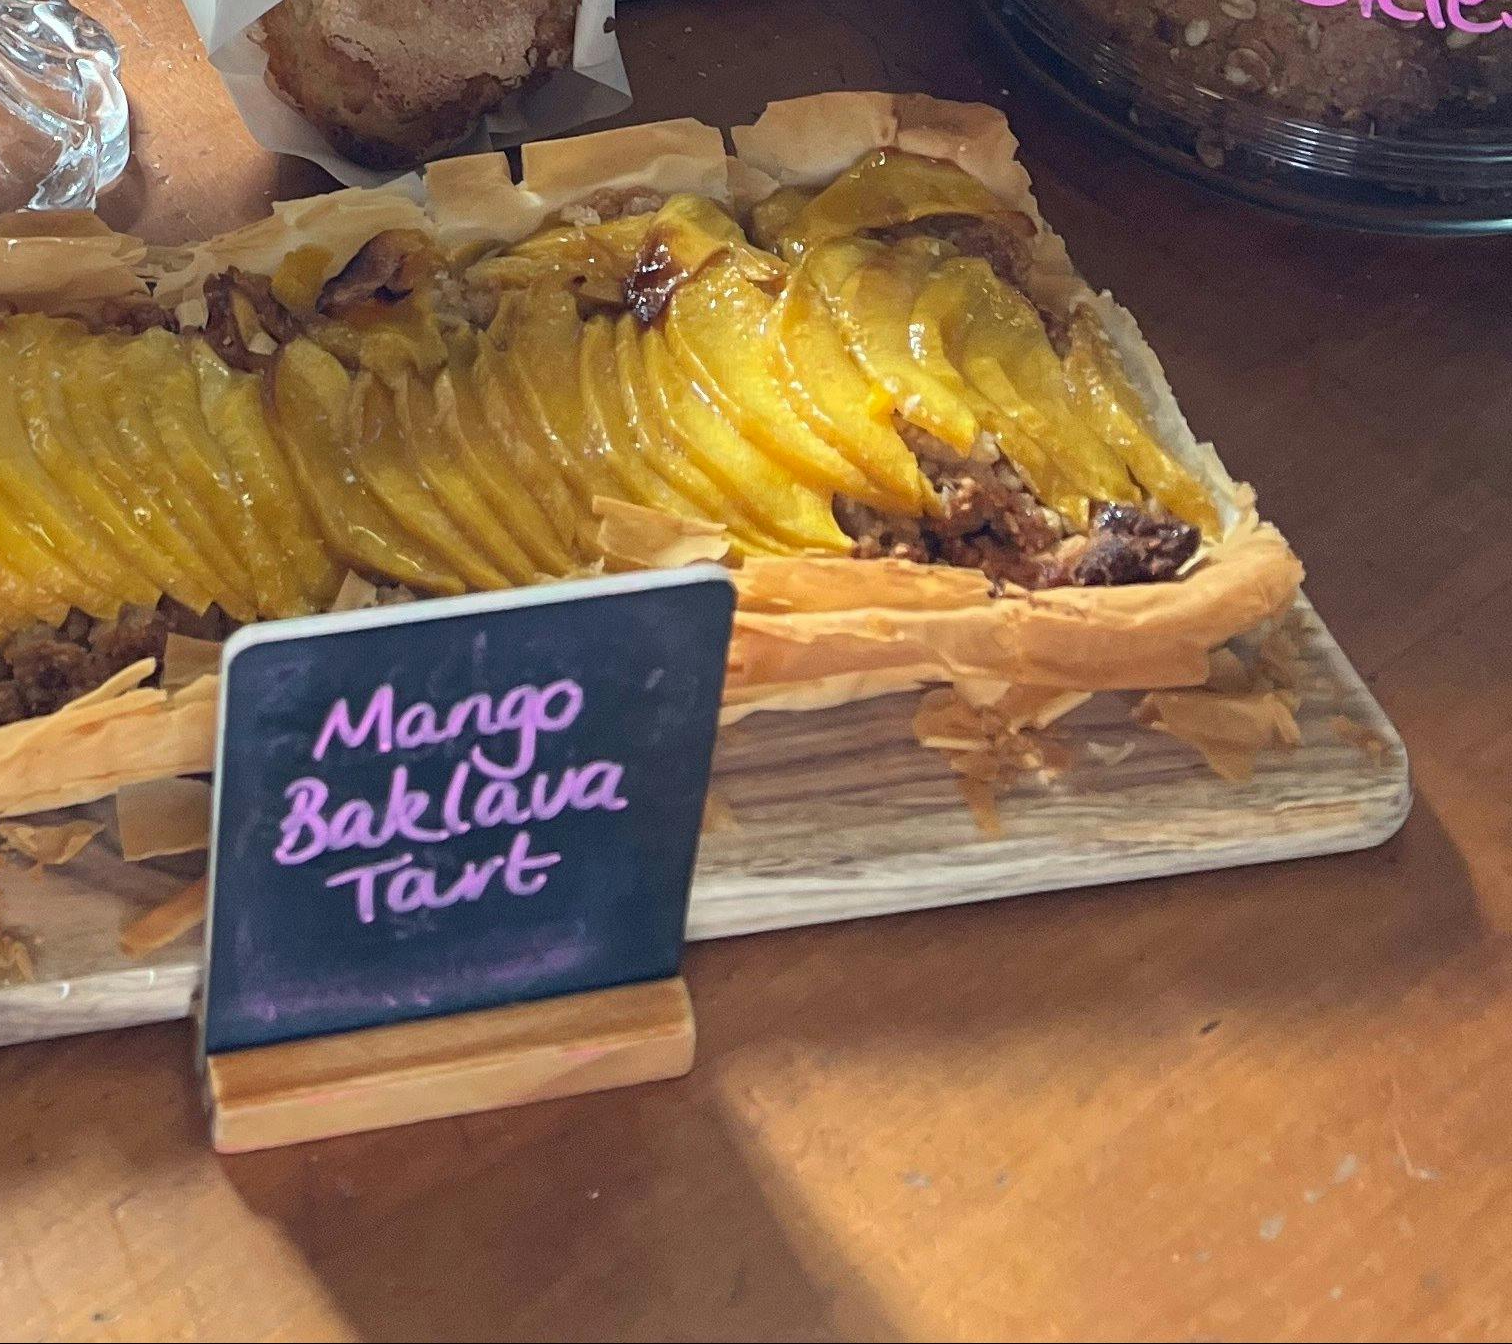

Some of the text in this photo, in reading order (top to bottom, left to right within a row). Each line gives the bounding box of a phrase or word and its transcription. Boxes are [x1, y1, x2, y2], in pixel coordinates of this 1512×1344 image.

[312, 677, 584, 781] Mango
[274, 758, 628, 865] Baklava
[327, 831, 561, 923] Tart
